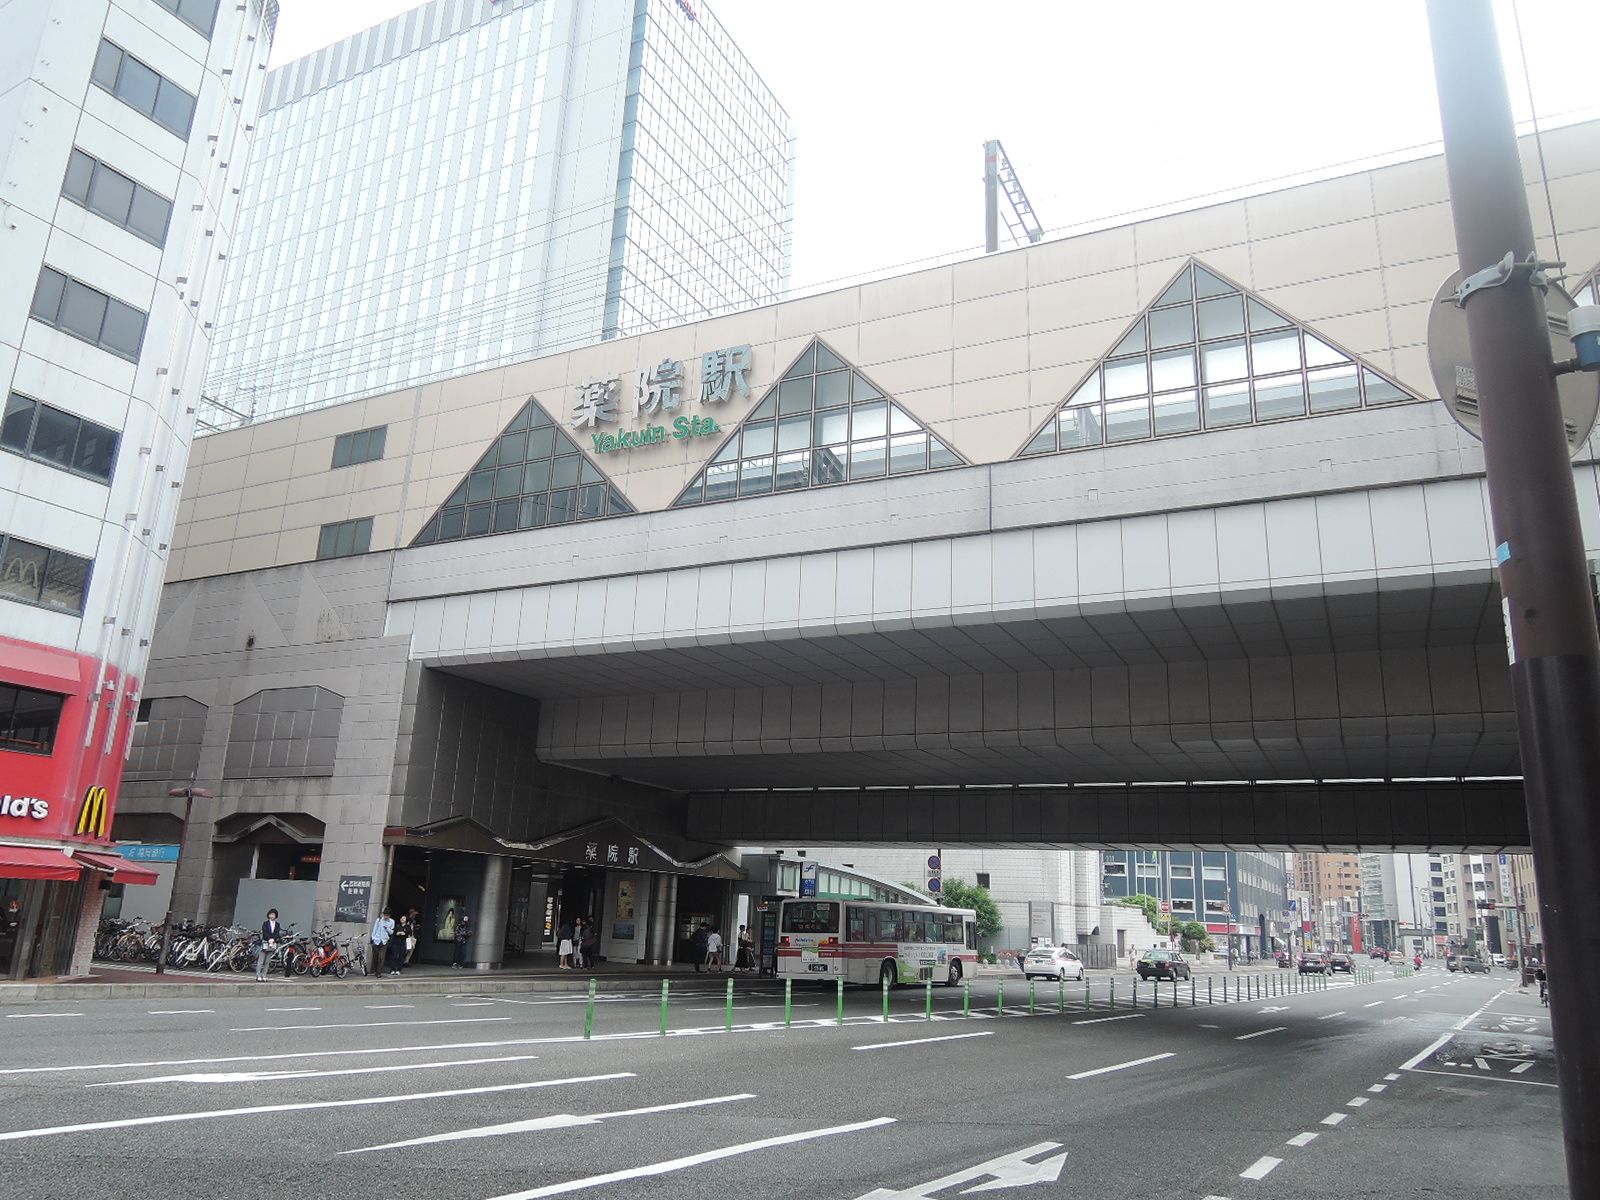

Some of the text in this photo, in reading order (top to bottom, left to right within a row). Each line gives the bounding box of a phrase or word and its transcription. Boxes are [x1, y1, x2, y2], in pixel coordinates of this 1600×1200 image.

[571, 344, 752, 430] 薬院駅
[592, 415, 722, 453] Yakuin Sta.
[585, 842, 640, 864] 薬院駅
